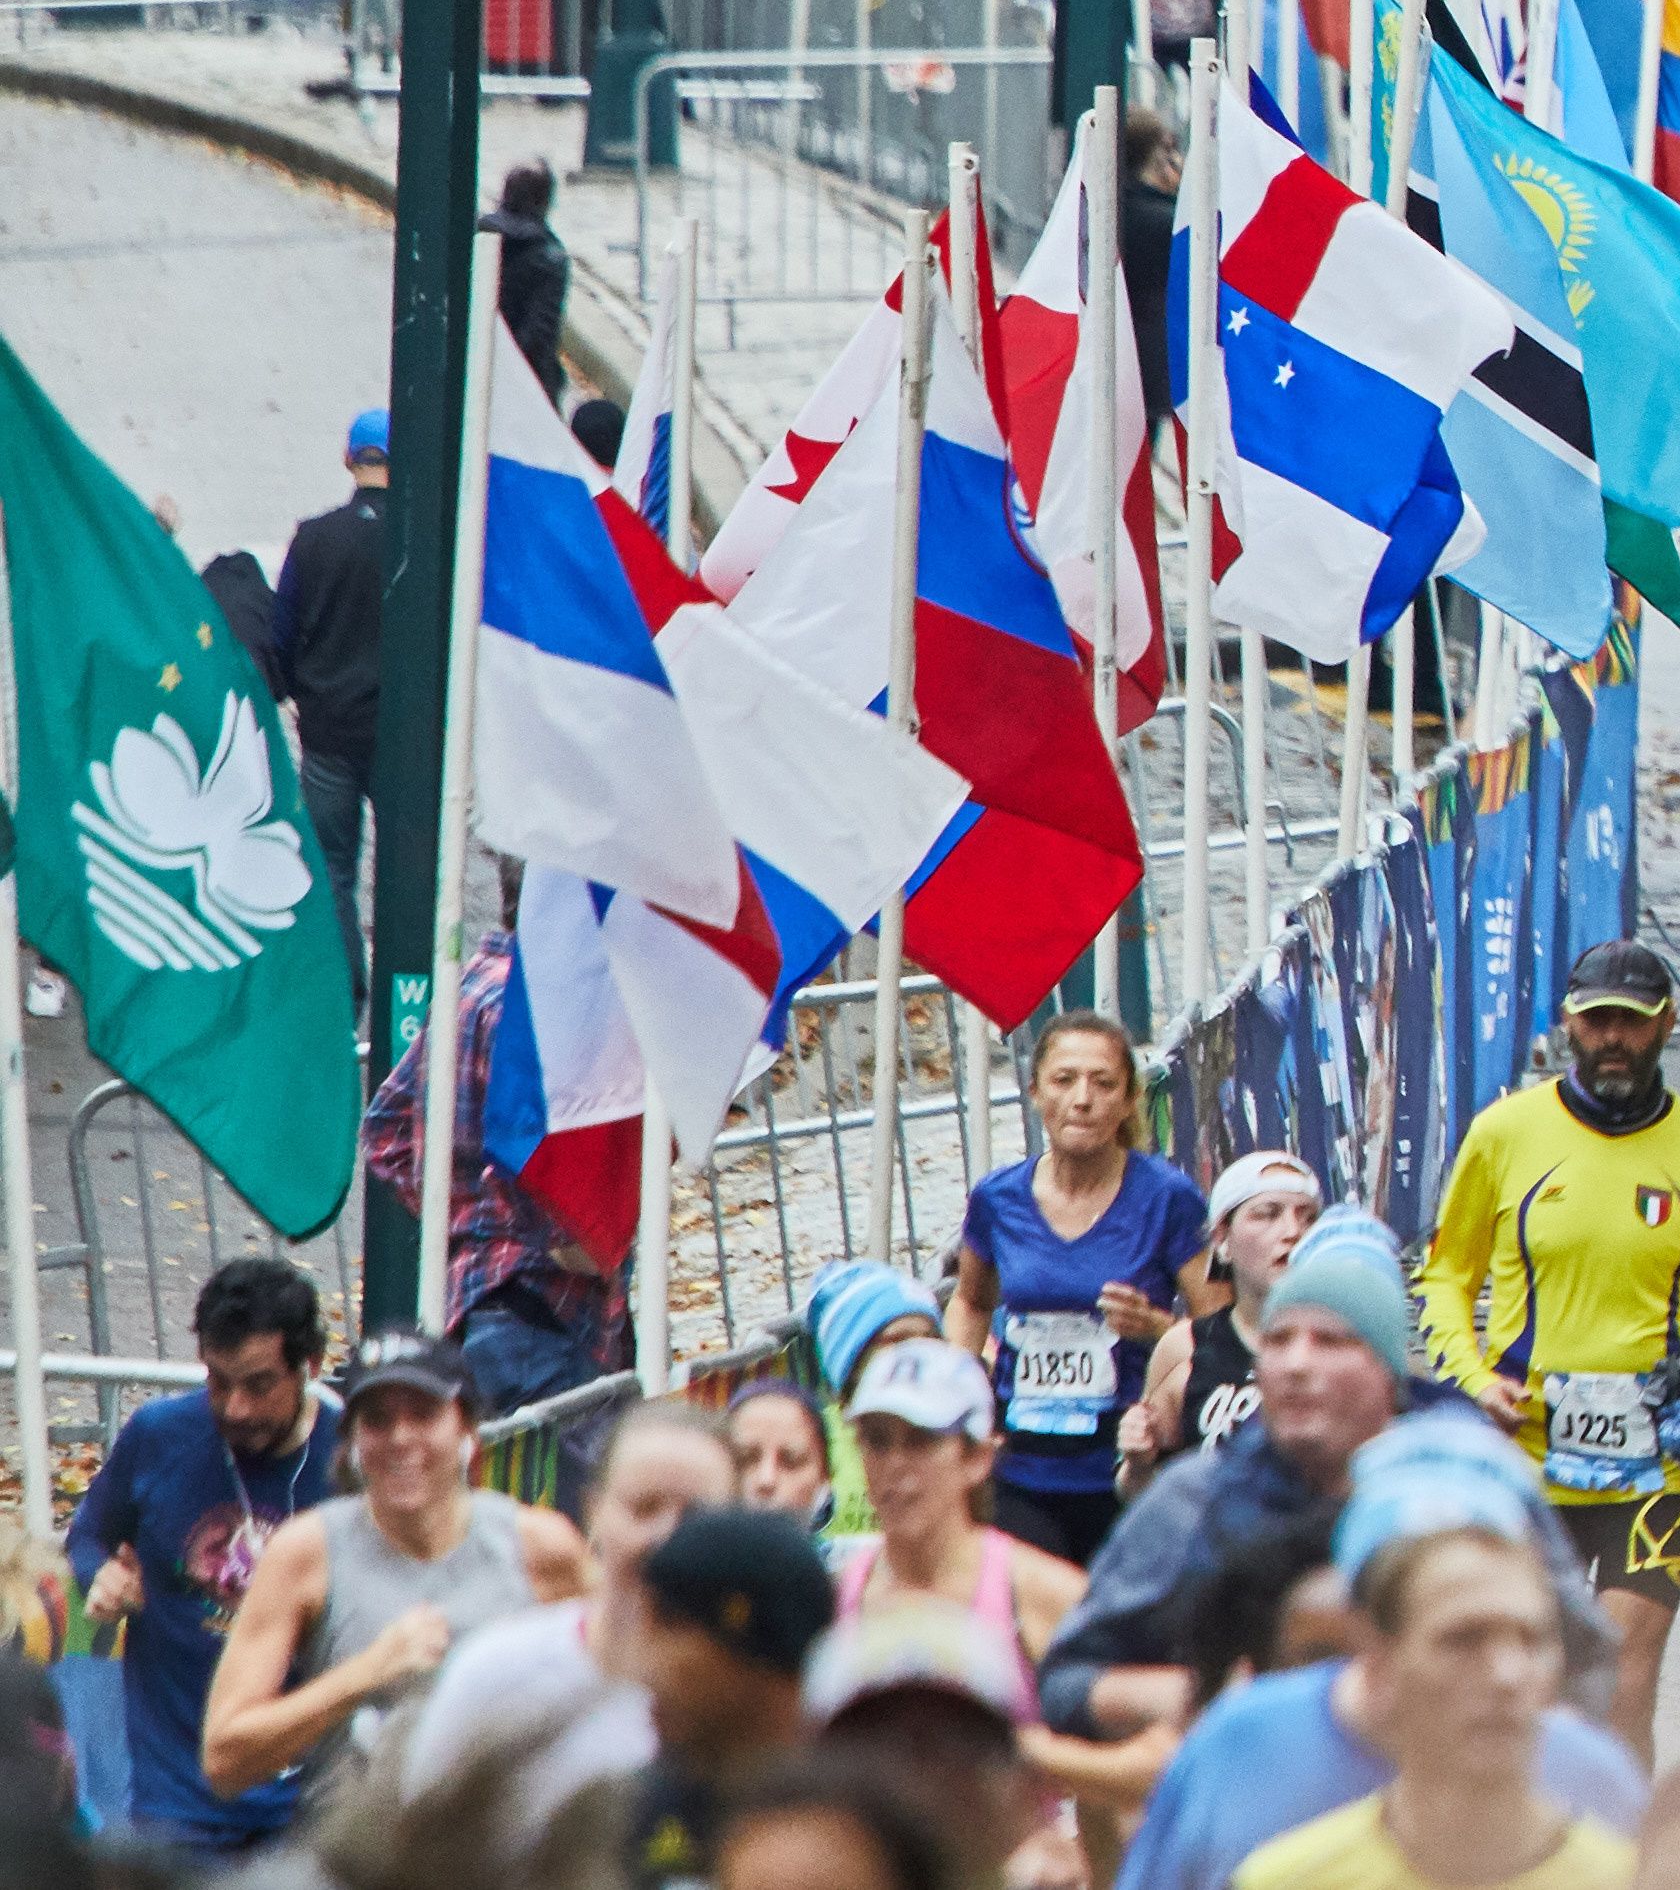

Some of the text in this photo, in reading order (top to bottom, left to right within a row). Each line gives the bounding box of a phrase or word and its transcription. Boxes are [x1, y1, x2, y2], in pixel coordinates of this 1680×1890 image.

[398, 979, 428, 1005] W
[1020, 1351, 1094, 1386] J1850
[1560, 1413, 1628, 1449] J225
